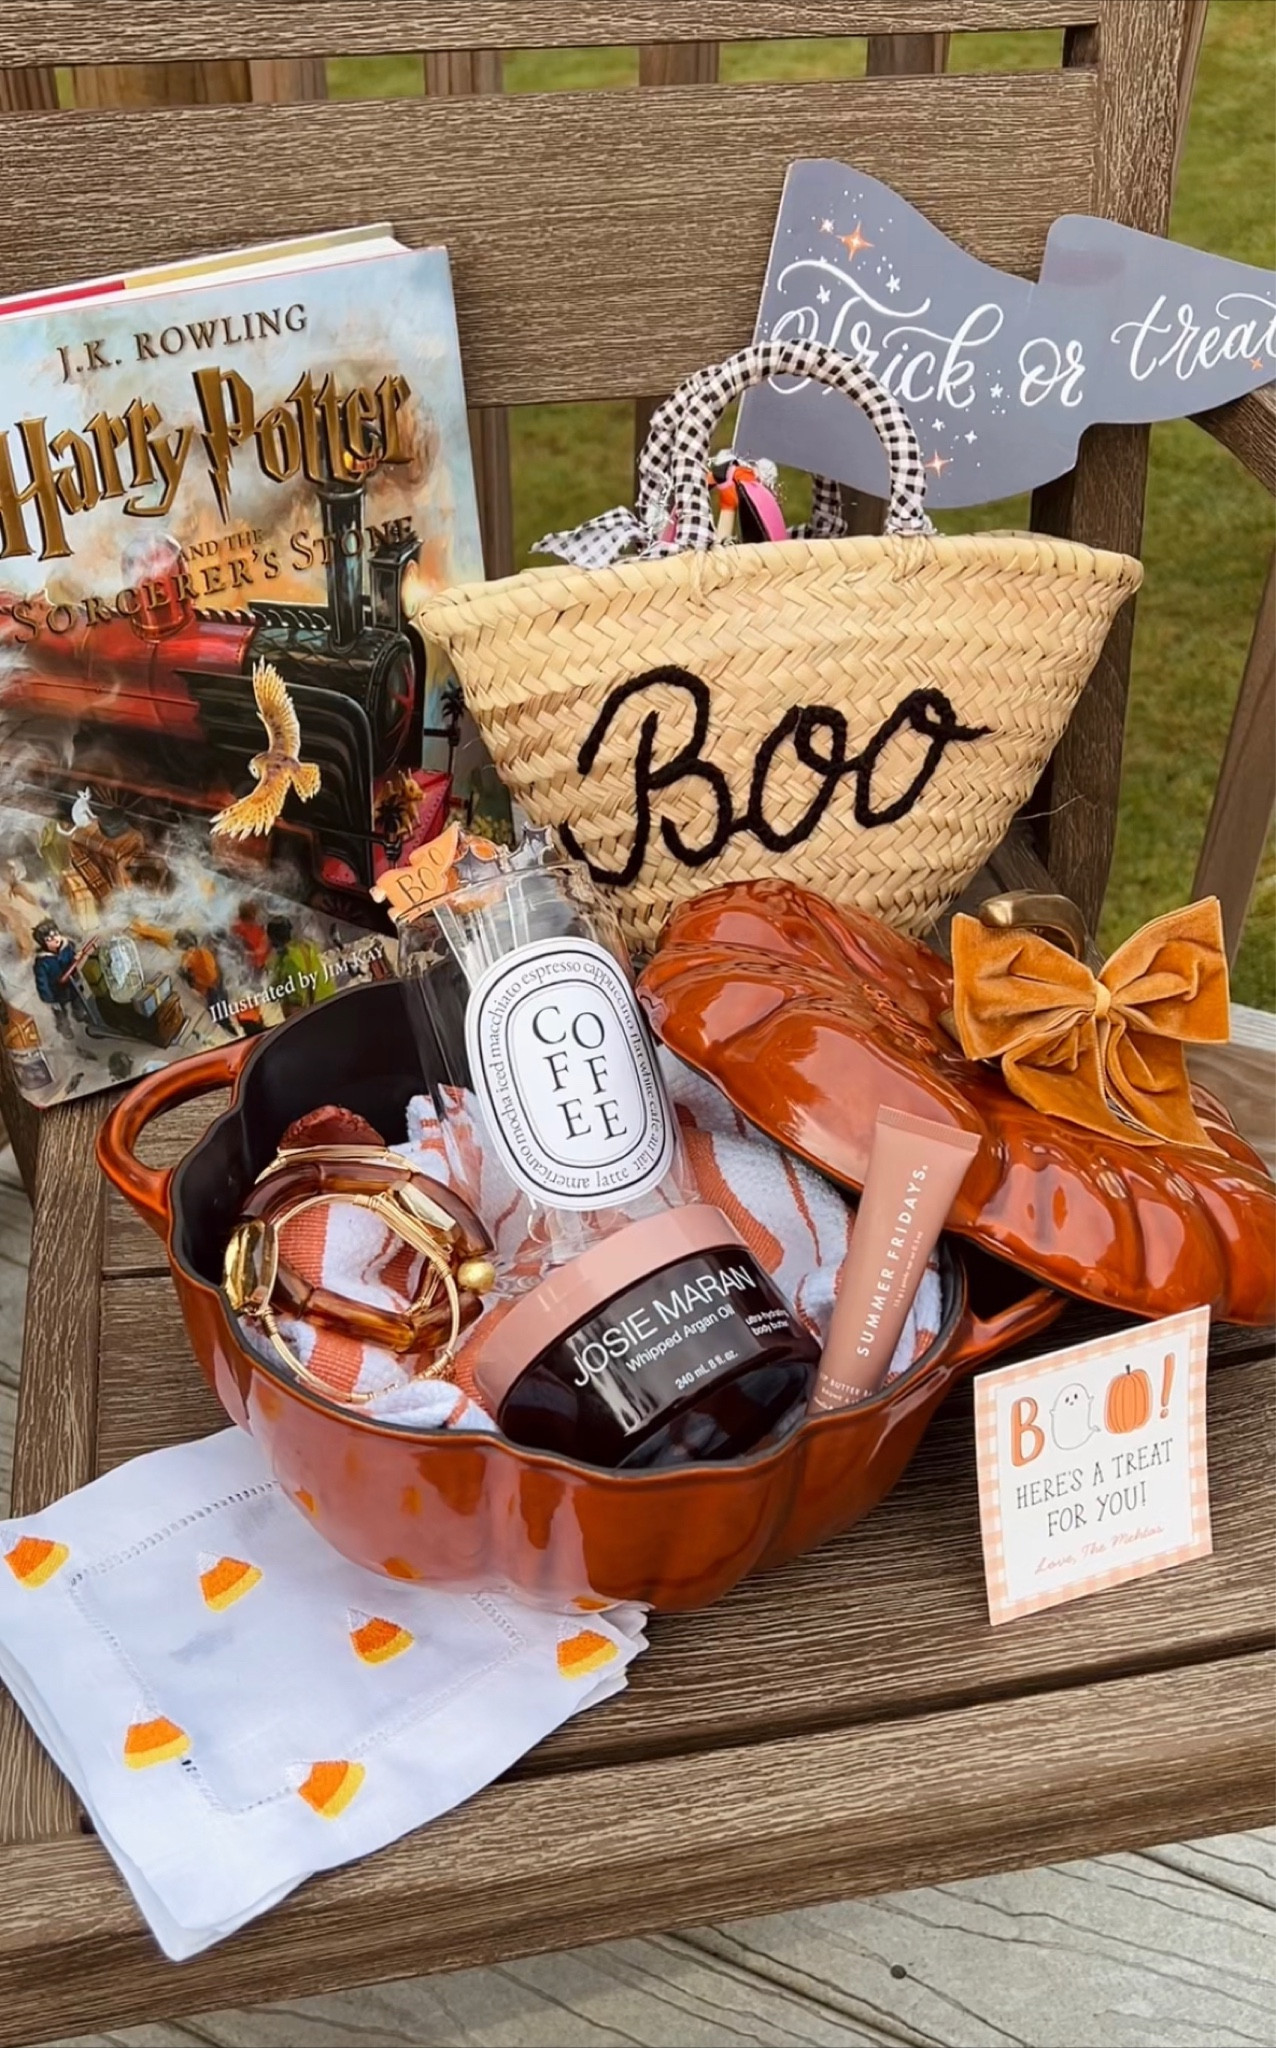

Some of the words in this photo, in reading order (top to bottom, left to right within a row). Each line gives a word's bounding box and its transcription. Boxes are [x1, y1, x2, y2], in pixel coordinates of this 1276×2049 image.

[134, 303, 308, 363] ROWLING
[1018, 337, 1086, 408] or
[0, 396, 195, 562] Harry
[192, 364, 414, 526] Potter
[177, 541, 219, 564] AND
[223, 527, 264, 553] THE
[559, 664, 991, 887] Boo
[209, 974, 296, 1023] Illustrated
[299, 970, 318, 990] by
[521, 960, 582, 986] espresso
[582, 961, 635, 1031] cappuccino
[487, 981, 522, 1060] macchiato
[488, 1061, 509, 1096] iced
[639, 1060, 655, 1099] white
[501, 1095, 527, 1147] mocha
[523, 1147, 591, 1191] americano
[596, 1166, 630, 1189] latte
[574, 1308, 653, 1387] JOSIE
[651, 1264, 757, 1325] MARAN
[683, 1313, 719, 1339] Argan
[717, 1303, 736, 1323] Oil
[750, 1324, 772, 1336] body
[857, 1266, 896, 1357] SUMMER
[675, 1372, 695, 1390] 240
[708, 1359, 717, 1369] 8
[1016, 1468, 1083, 1510] HERE'S
[1092, 1461, 1105, 1488] A
[1111, 1437, 1173, 1480] TREAT
[1047, 1503, 1087, 1537] FOR
[1096, 1480, 1147, 1522] YOU!
[1035, 1555, 1077, 1575] Love,
[1081, 1541, 1107, 1557] The
